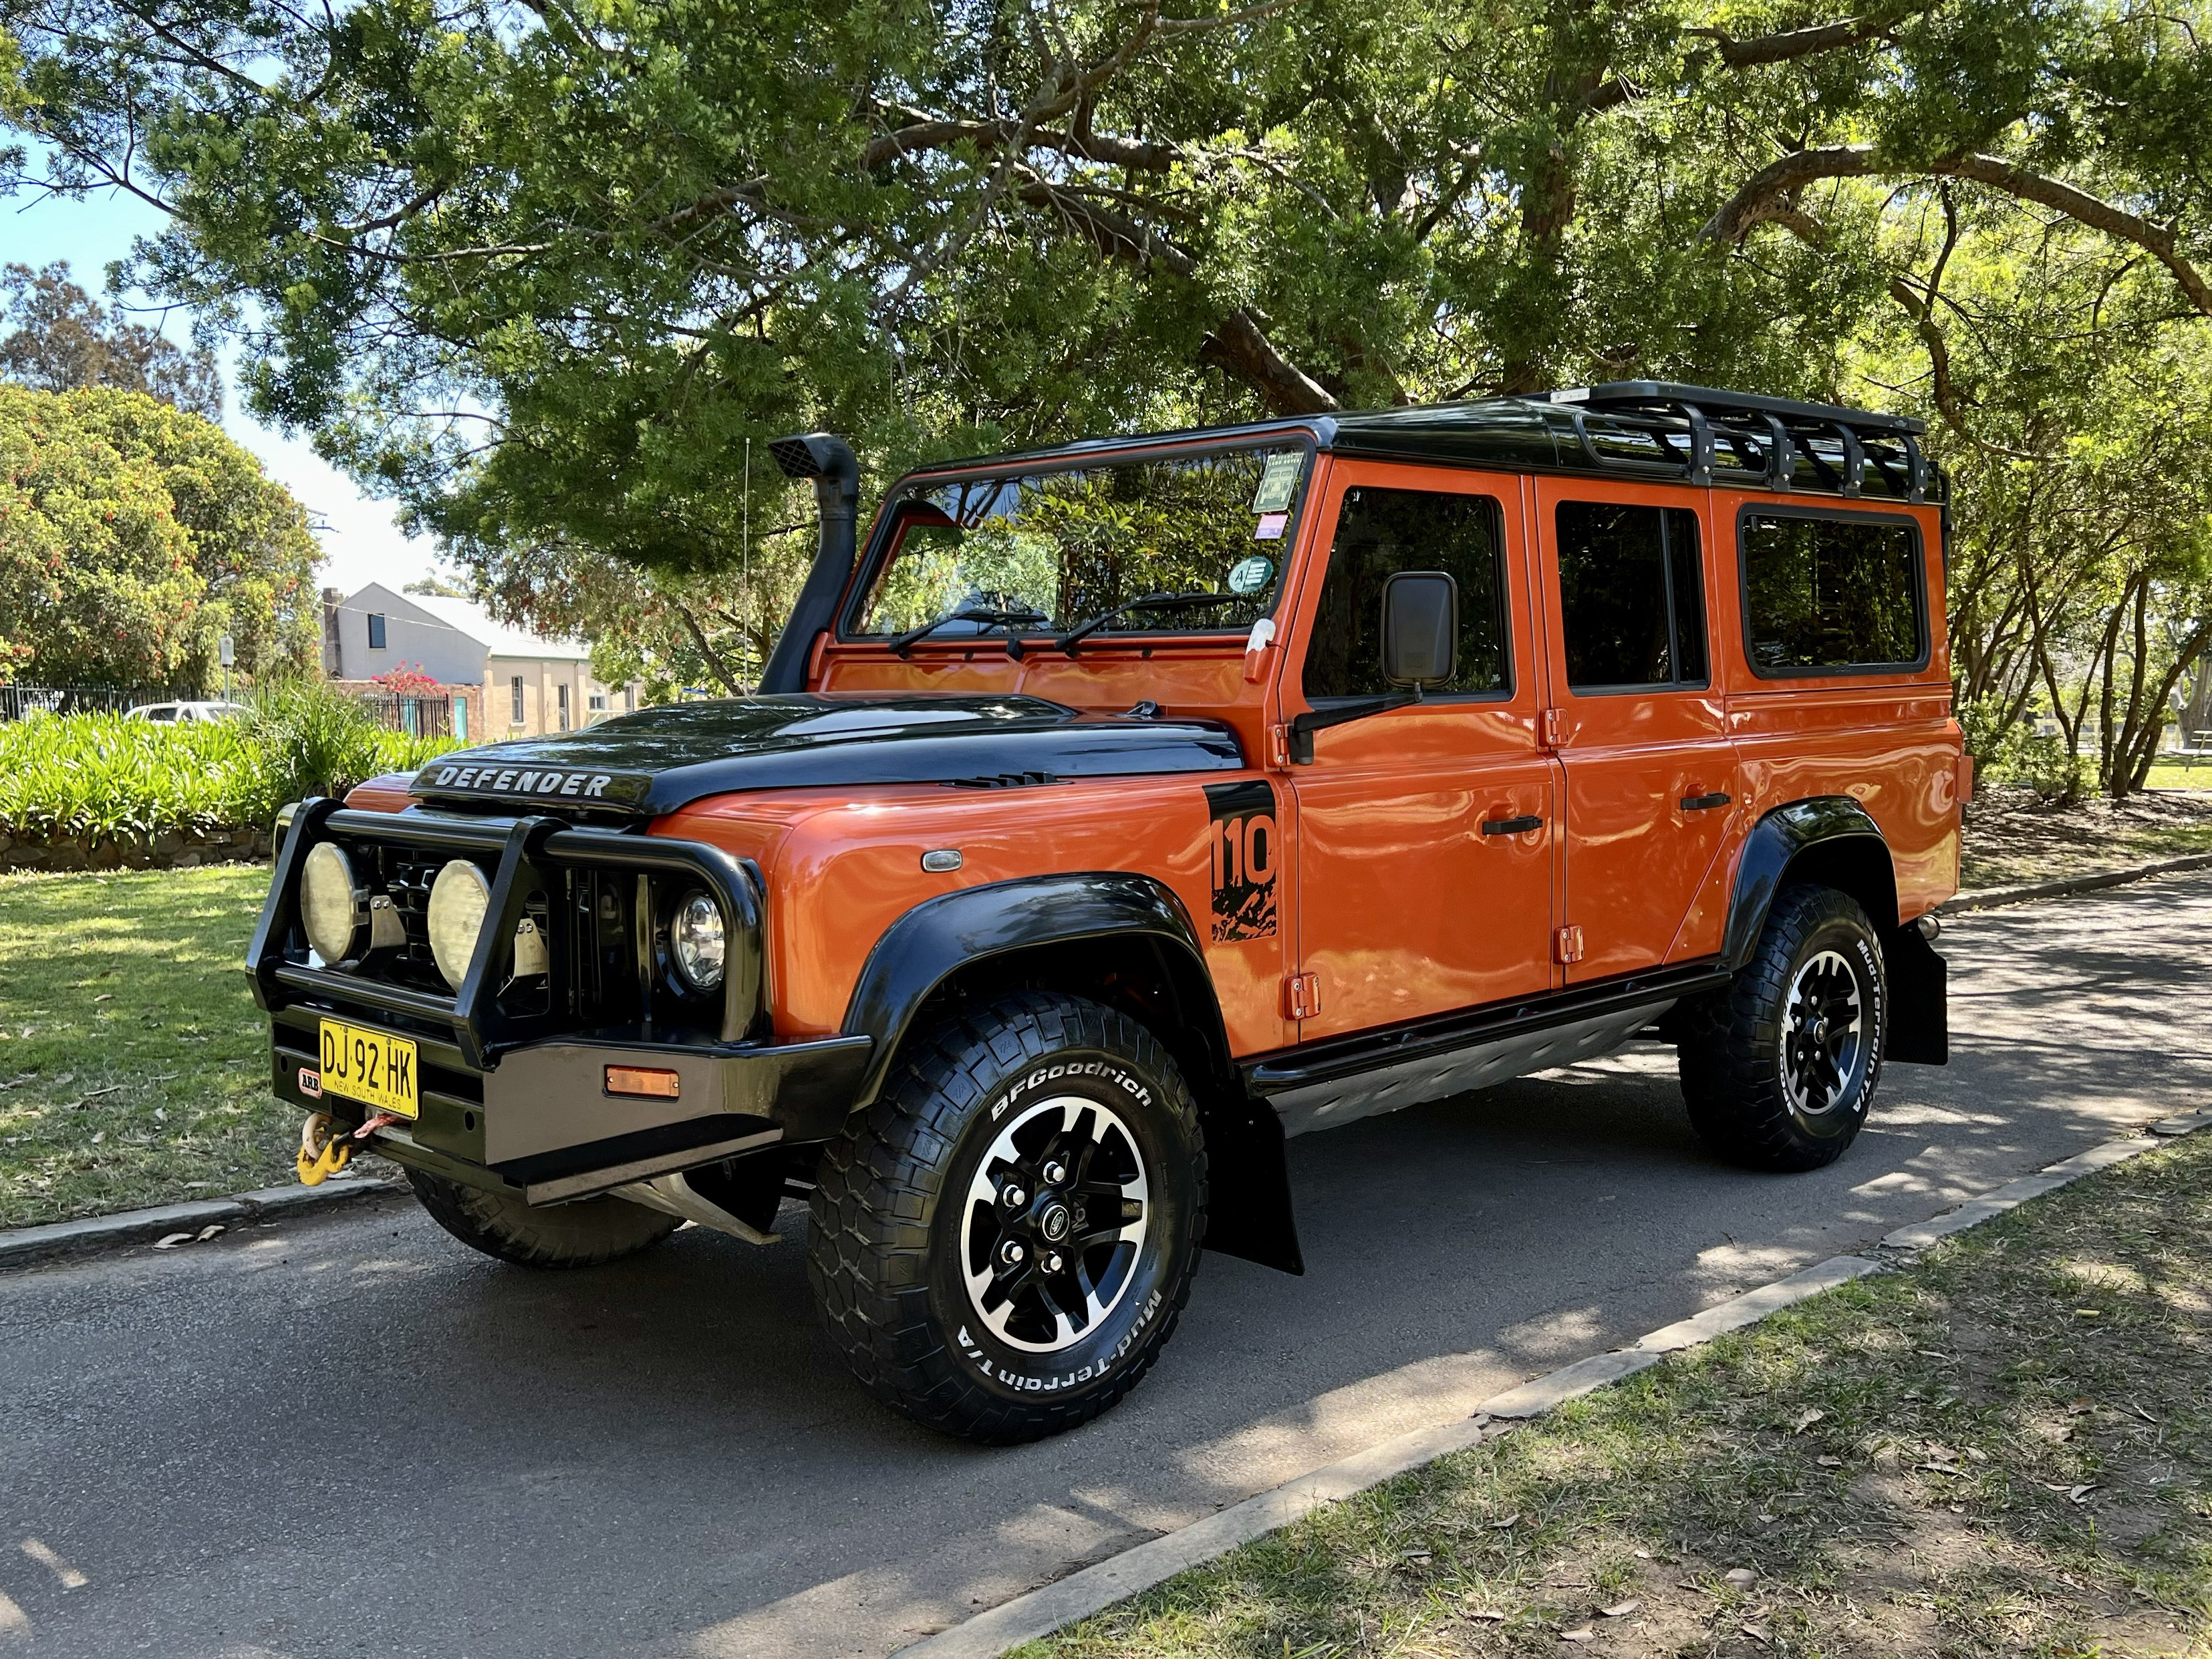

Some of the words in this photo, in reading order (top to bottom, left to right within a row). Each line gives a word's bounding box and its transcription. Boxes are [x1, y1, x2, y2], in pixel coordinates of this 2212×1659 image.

[434, 766, 611, 797] DEFENDER
[1210, 814, 1276, 890] 110
[1856, 939, 1881, 1074] Mud-Terrain
[302, 1074, 319, 1092] ARB
[334, 1080, 350, 1093] NEW
[352, 1085, 376, 1104] SOUTH
[378, 1094, 402, 1110] WALES
[990, 1060, 1153, 1122] BFGoodrich
[957, 1324, 994, 1378] T/A
[998, 1288, 1163, 1392] Mud-Terrain
